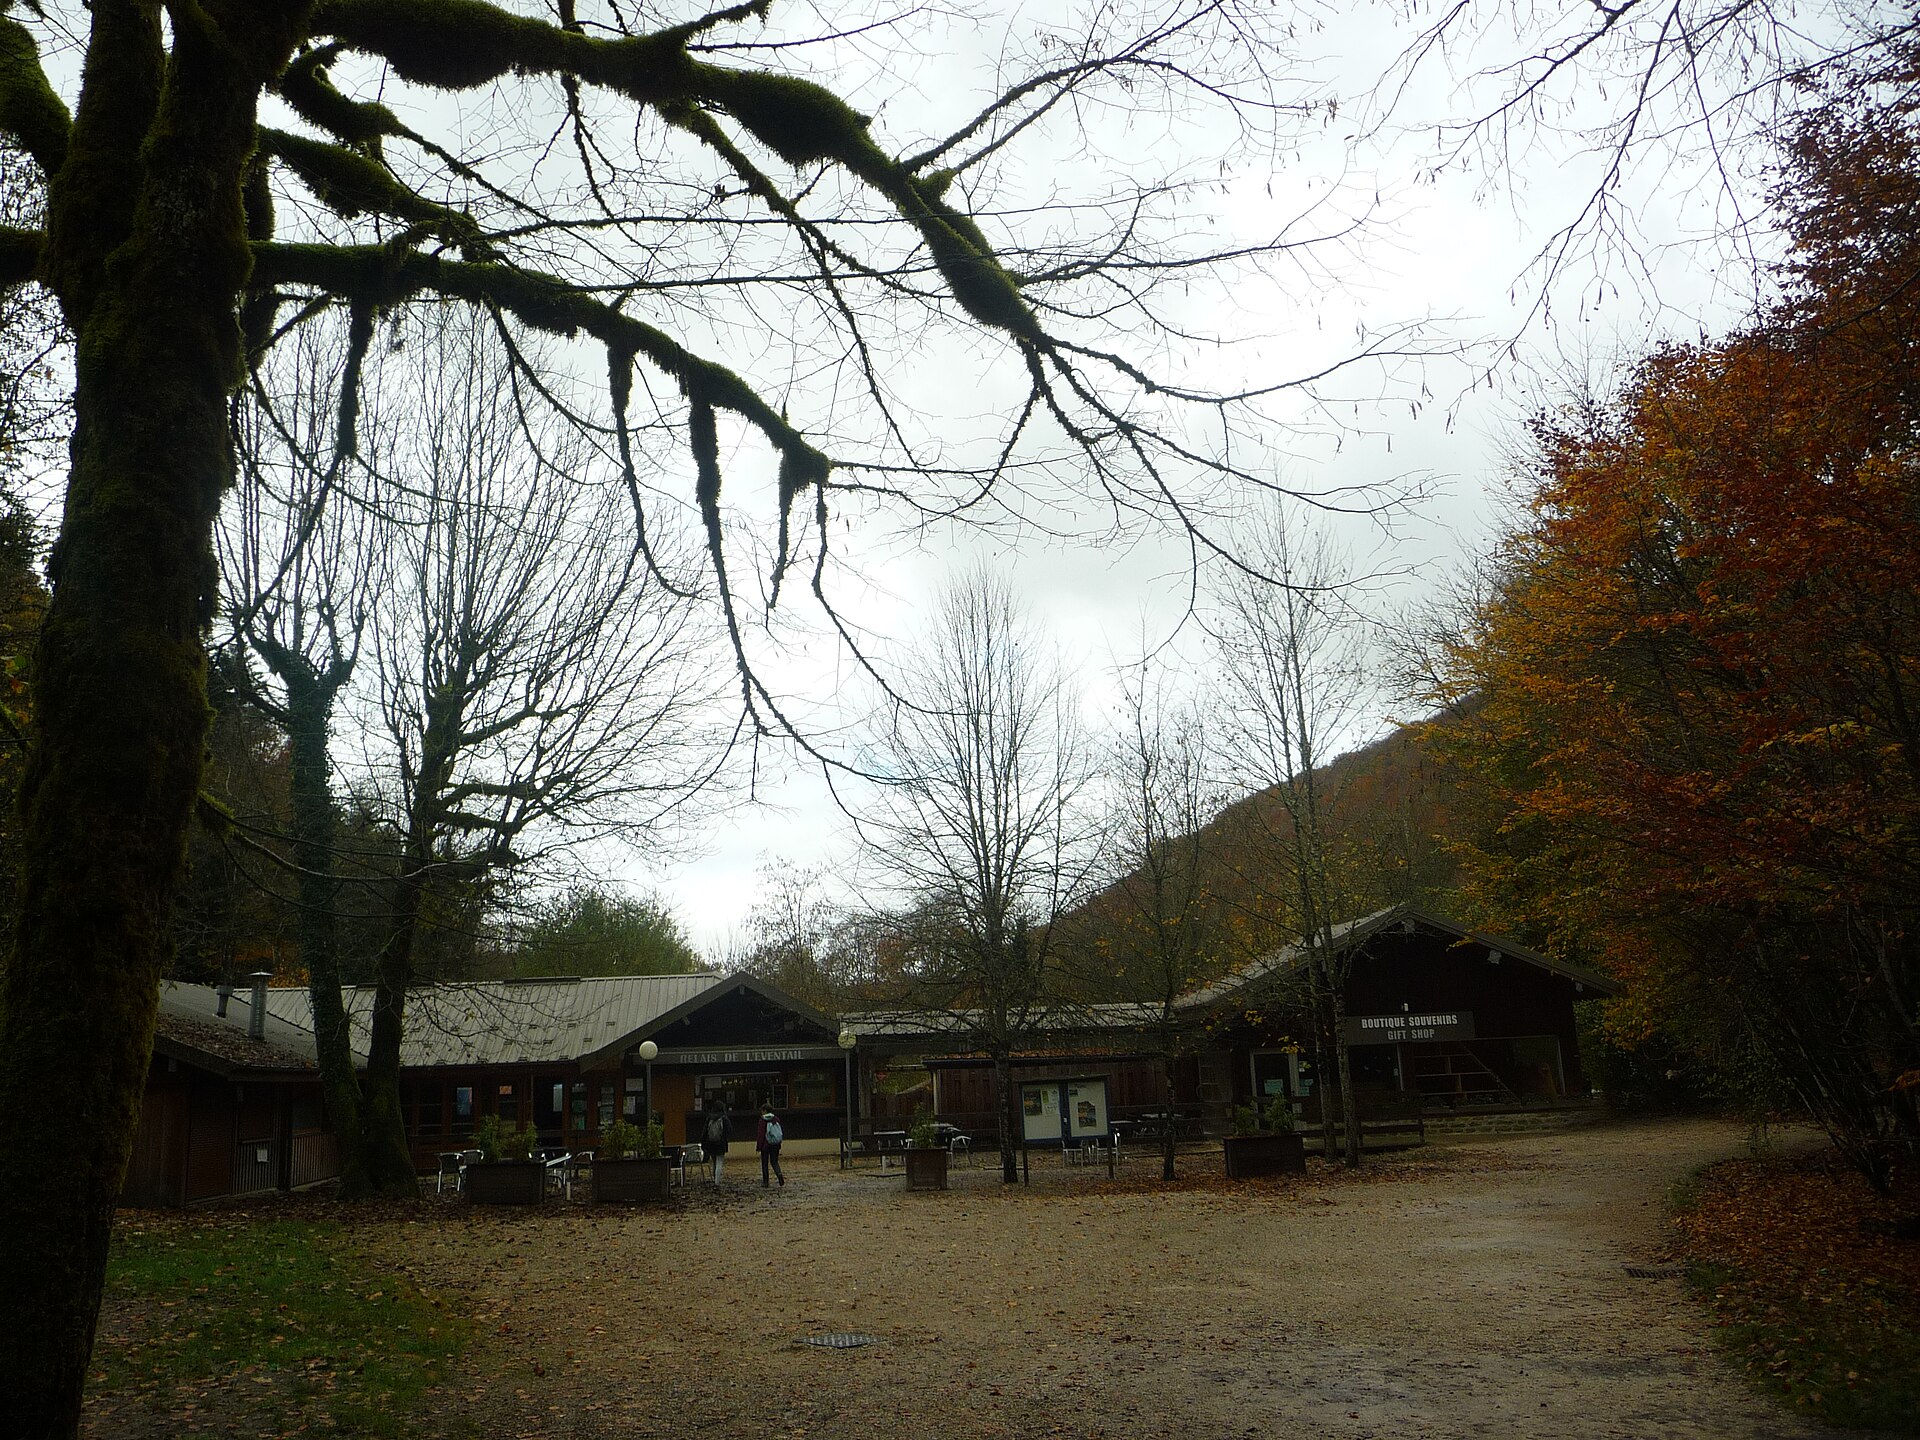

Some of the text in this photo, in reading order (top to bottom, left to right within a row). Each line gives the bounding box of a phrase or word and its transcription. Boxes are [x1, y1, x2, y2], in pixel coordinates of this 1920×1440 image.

[1361, 1014, 1458, 1028] BOUTIQUE SOUVENIRS
[1387, 1029, 1435, 1040] GIFT SHOP
[680, 1053, 717, 1064] RELAIS
[724, 1052, 739, 1062] DE
